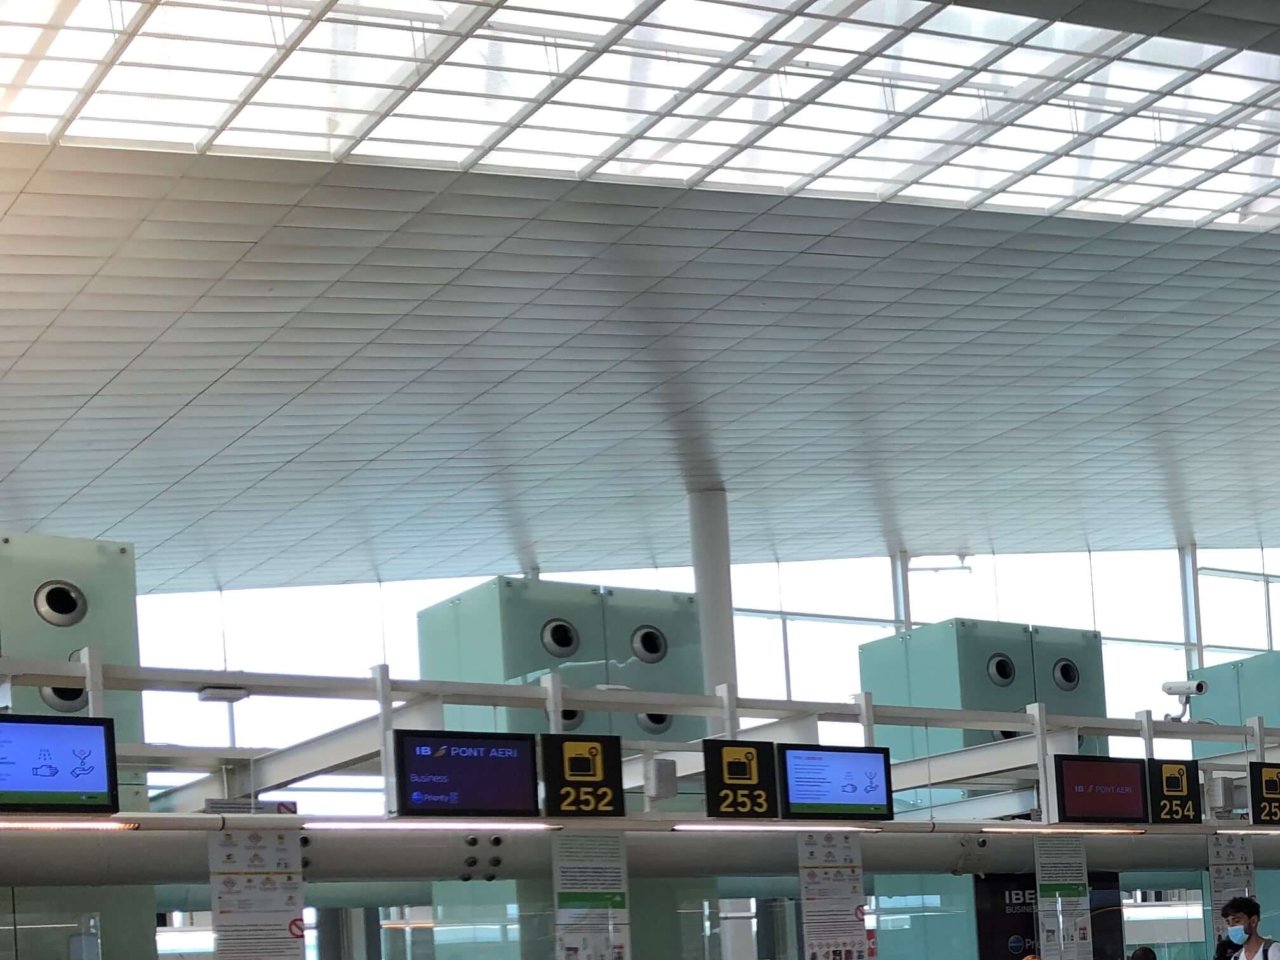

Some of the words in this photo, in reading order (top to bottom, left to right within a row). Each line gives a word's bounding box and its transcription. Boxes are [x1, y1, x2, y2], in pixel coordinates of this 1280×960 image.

[415, 746, 431, 756] IB
[451, 747, 486, 757] PONT
[489, 748, 518, 758] AERI
[410, 773, 448, 783] Business
[559, 786, 614, 811] 252
[718, 789, 769, 813] 253
[1159, 799, 1195, 820] 254
[1005, 889, 1036, 904] IBE
